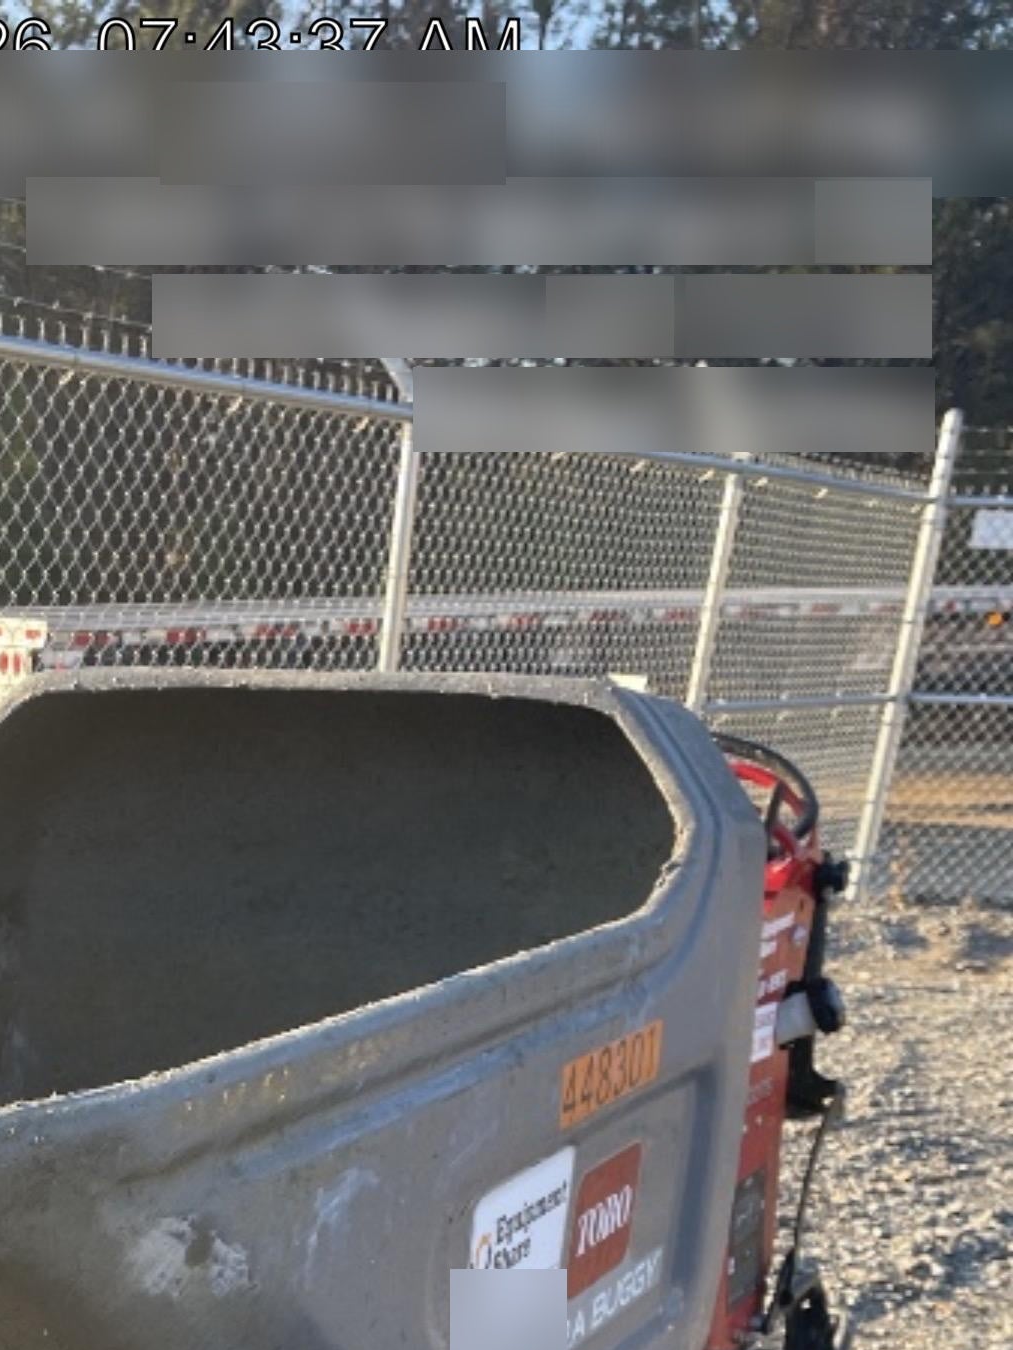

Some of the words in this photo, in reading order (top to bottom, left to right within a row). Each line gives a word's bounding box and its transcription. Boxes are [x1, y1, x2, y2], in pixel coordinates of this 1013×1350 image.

[495, 1179, 568, 1246] Equipment
[574, 1183, 633, 1258] TORO
[493, 1237, 531, 1269] Share
[590, 1247, 664, 1330] BUGGY
